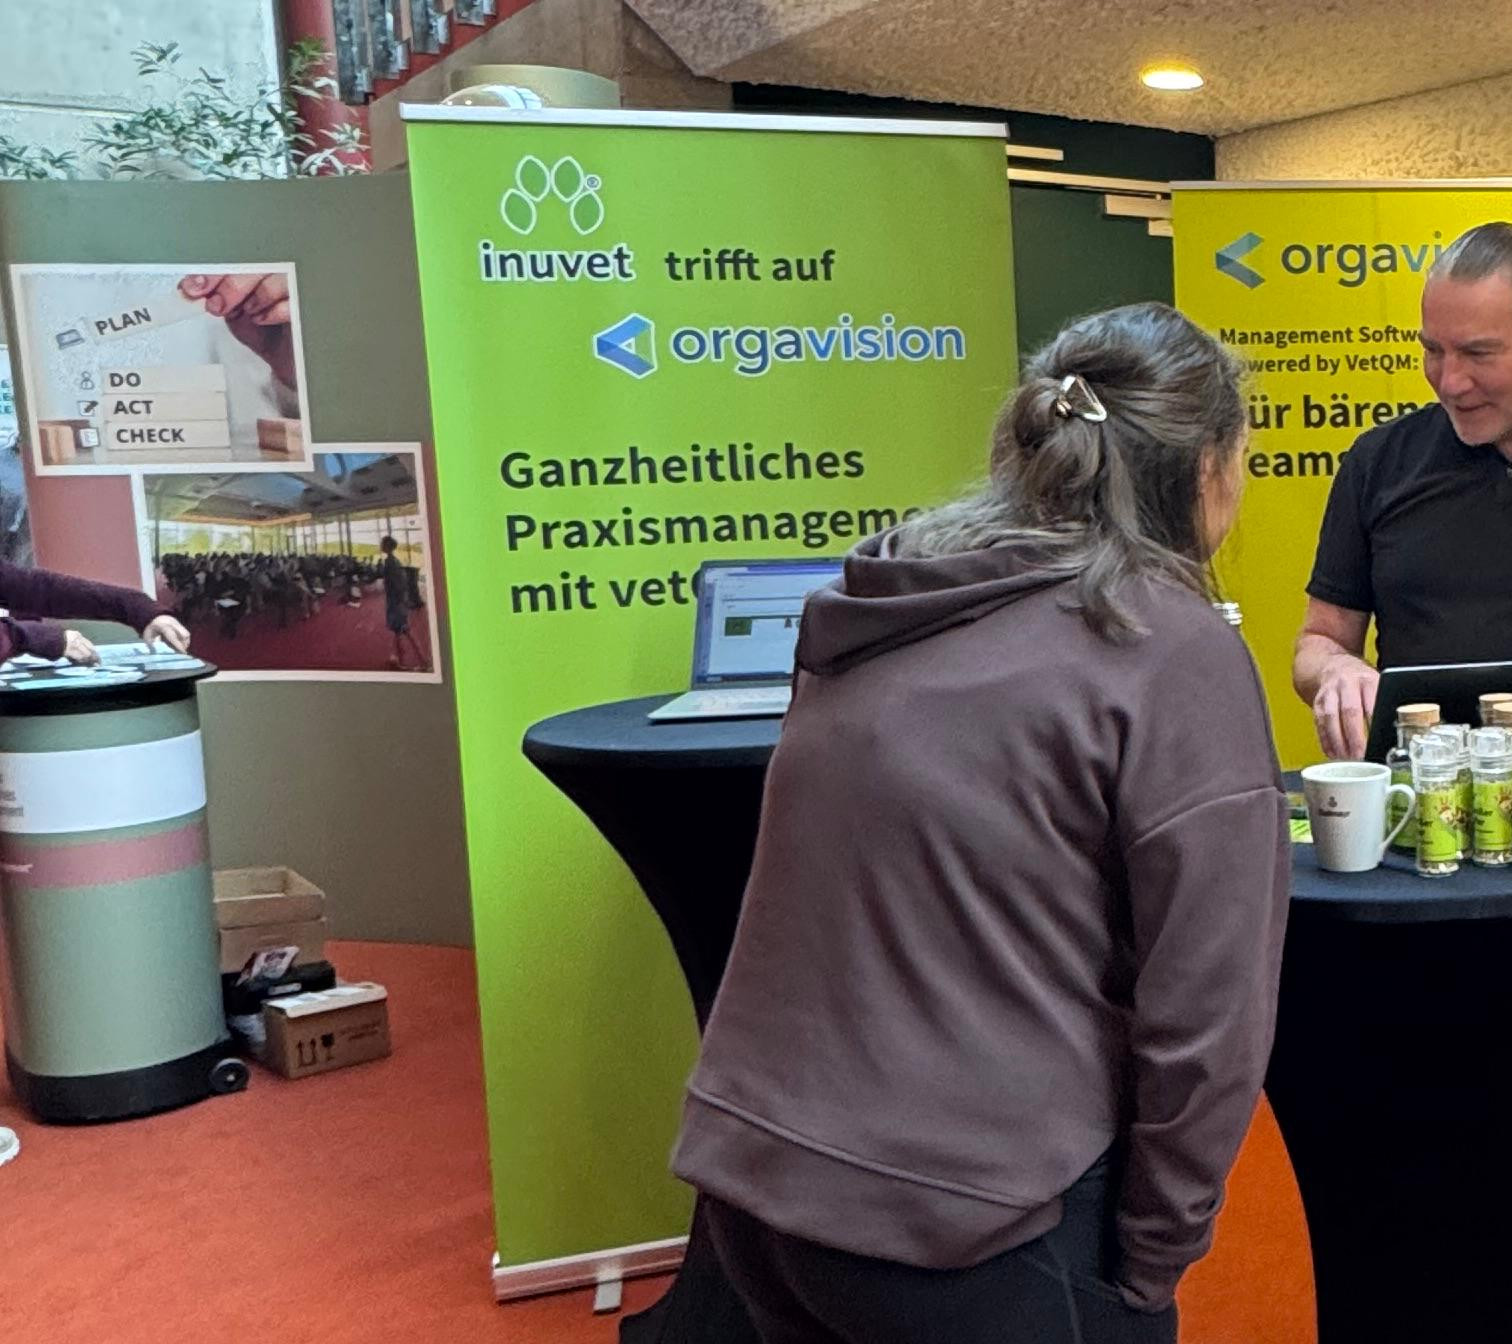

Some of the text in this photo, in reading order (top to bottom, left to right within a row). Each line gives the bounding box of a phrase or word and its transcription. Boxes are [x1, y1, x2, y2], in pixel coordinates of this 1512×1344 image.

[480, 240, 836, 281] inuvet trifft auf
[1281, 231, 1442, 288] orgavi
[95, 307, 152, 336] PLAN
[672, 315, 964, 375] orgavision
[1220, 327, 1353, 349] Management
[110, 373, 141, 387] DO
[1244, 354, 1419, 375] wered by VetQM:
[113, 400, 153, 415] ACT
[1250, 394, 1440, 429] ür bären
[116, 428, 185, 443] CHECK
[500, 442, 865, 489] Ganzheitliches
[1249, 450, 1349, 477] eam
[505, 506, 930, 552] Praxismanagem
[511, 571, 597, 614] mit
[608, 569, 700, 608] vet
